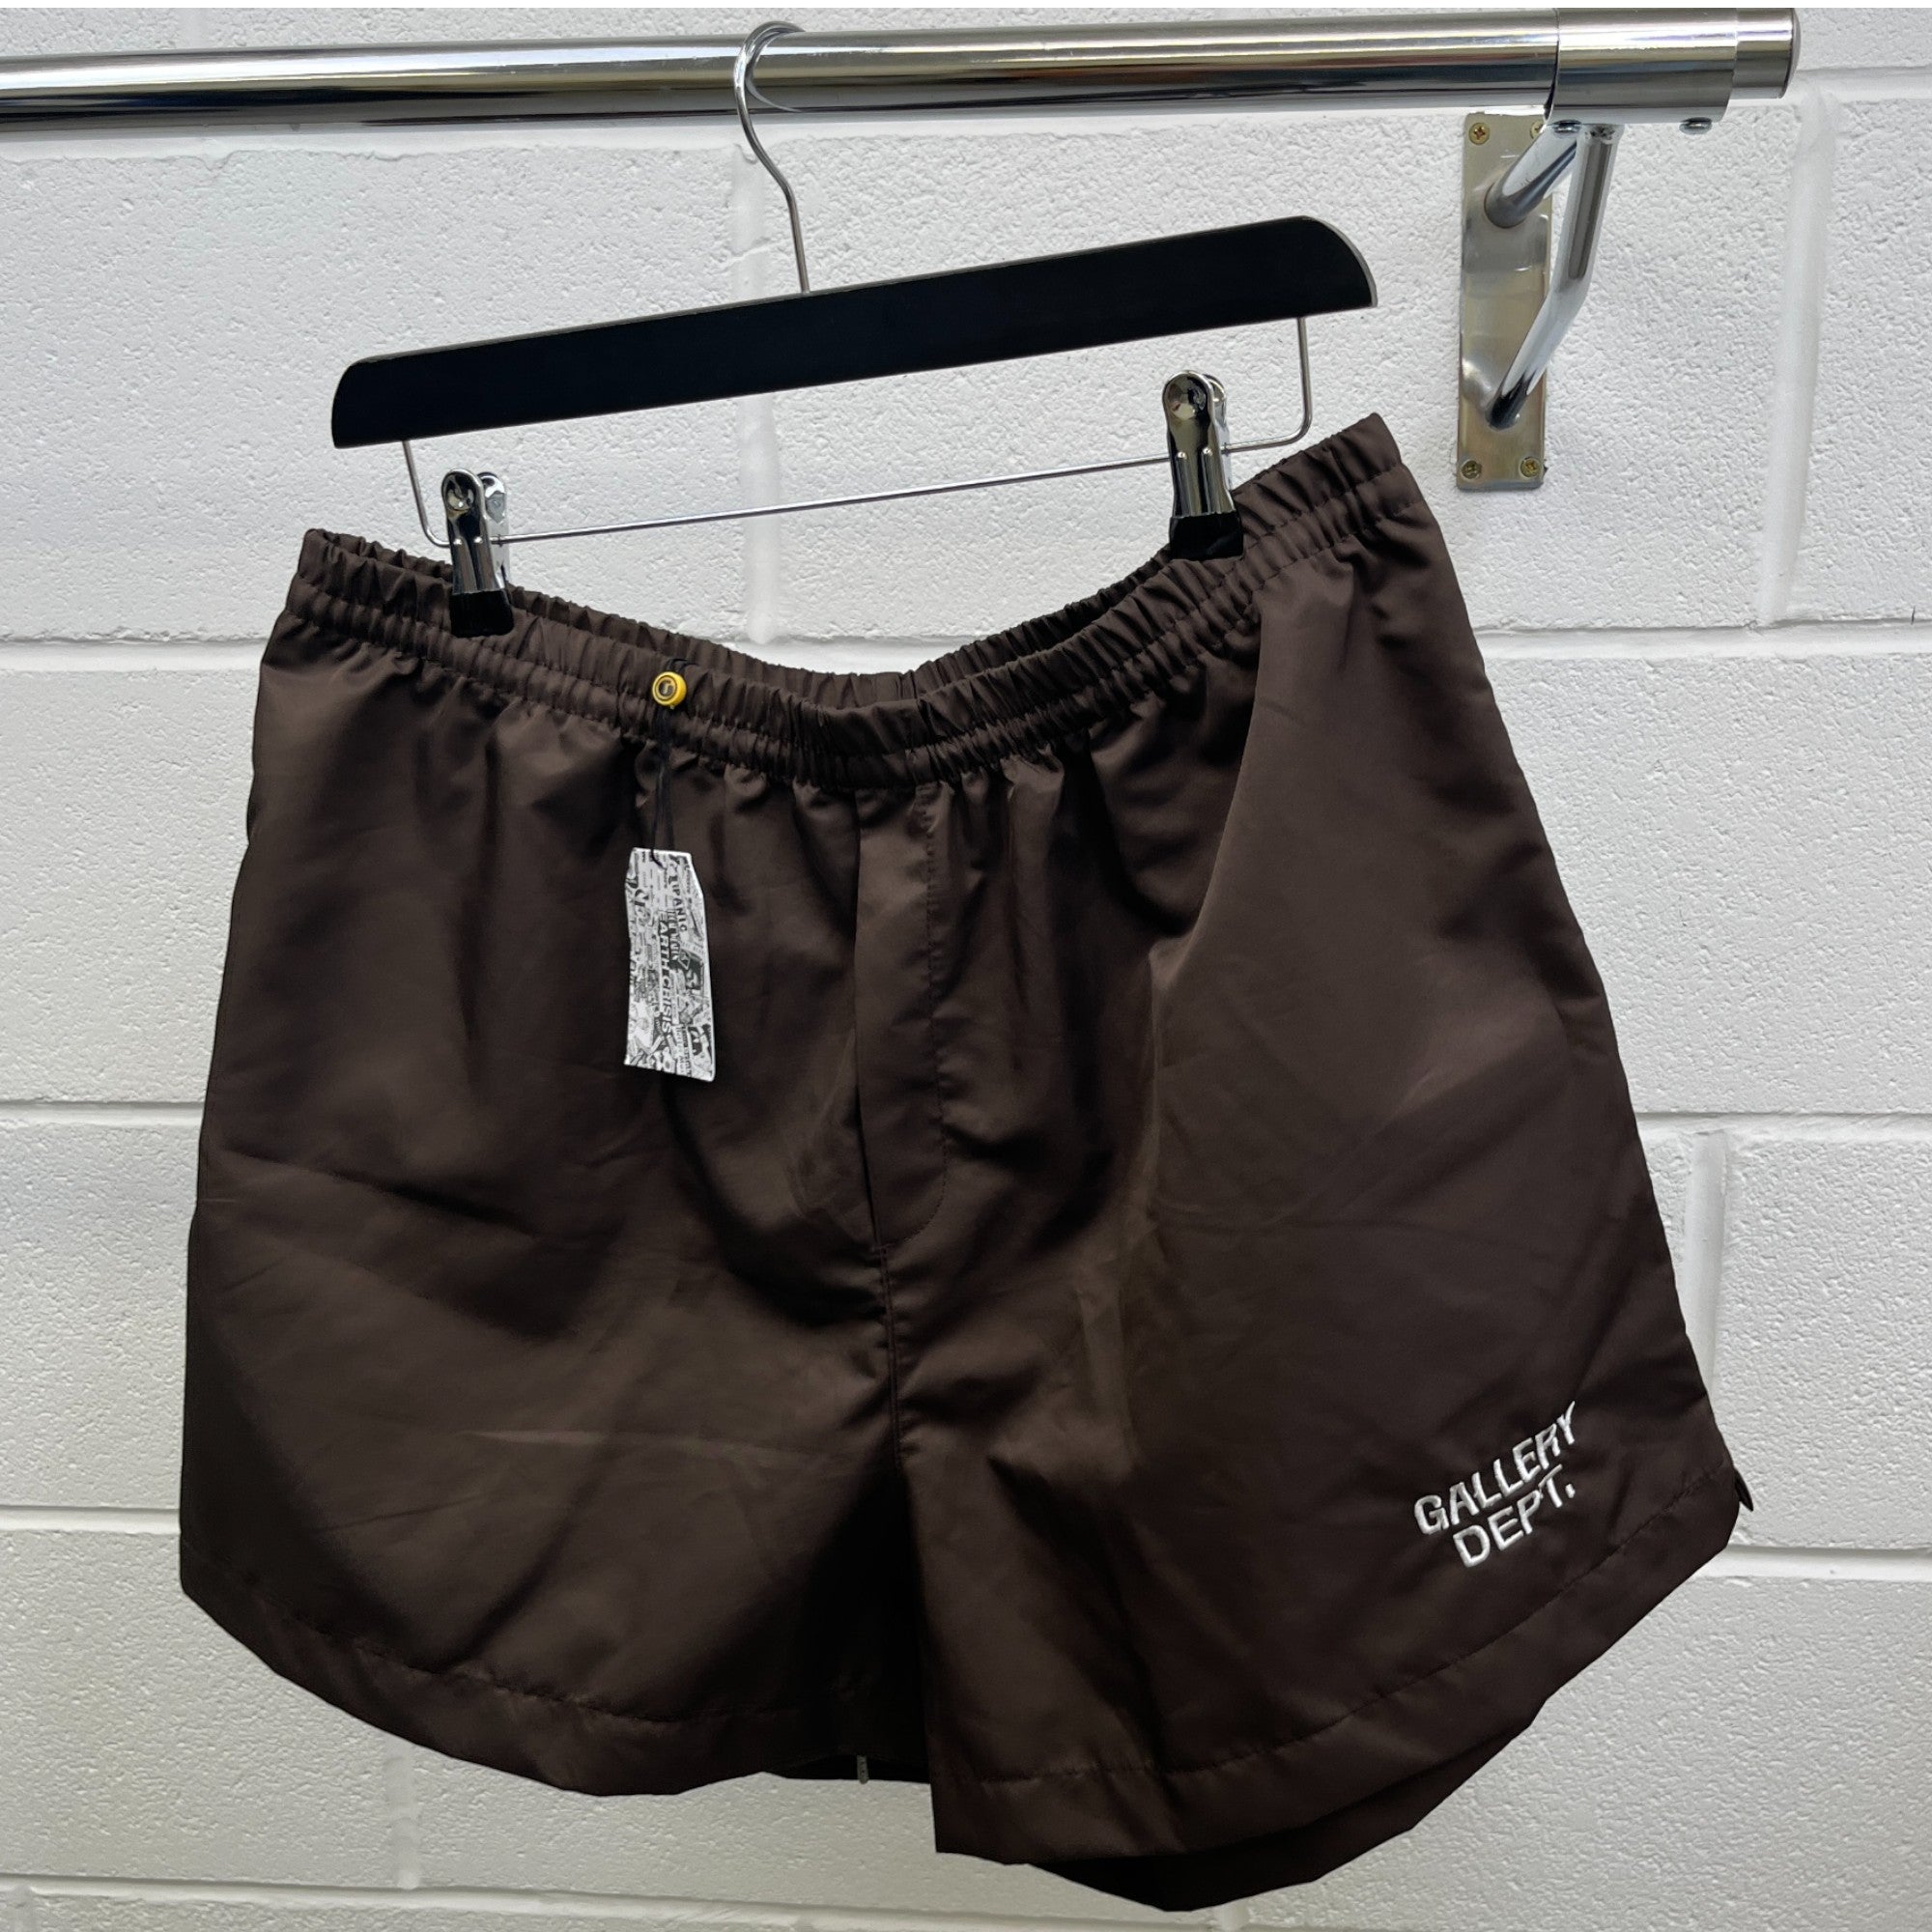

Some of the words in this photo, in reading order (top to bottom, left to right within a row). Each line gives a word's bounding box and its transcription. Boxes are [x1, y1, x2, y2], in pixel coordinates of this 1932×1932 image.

[658, 909, 669, 971] EARTH
[662, 975, 672, 1034] CRISIS
[1414, 1401, 1576, 1534] GALLERY
[1453, 1463, 1576, 1567] DEPT.
